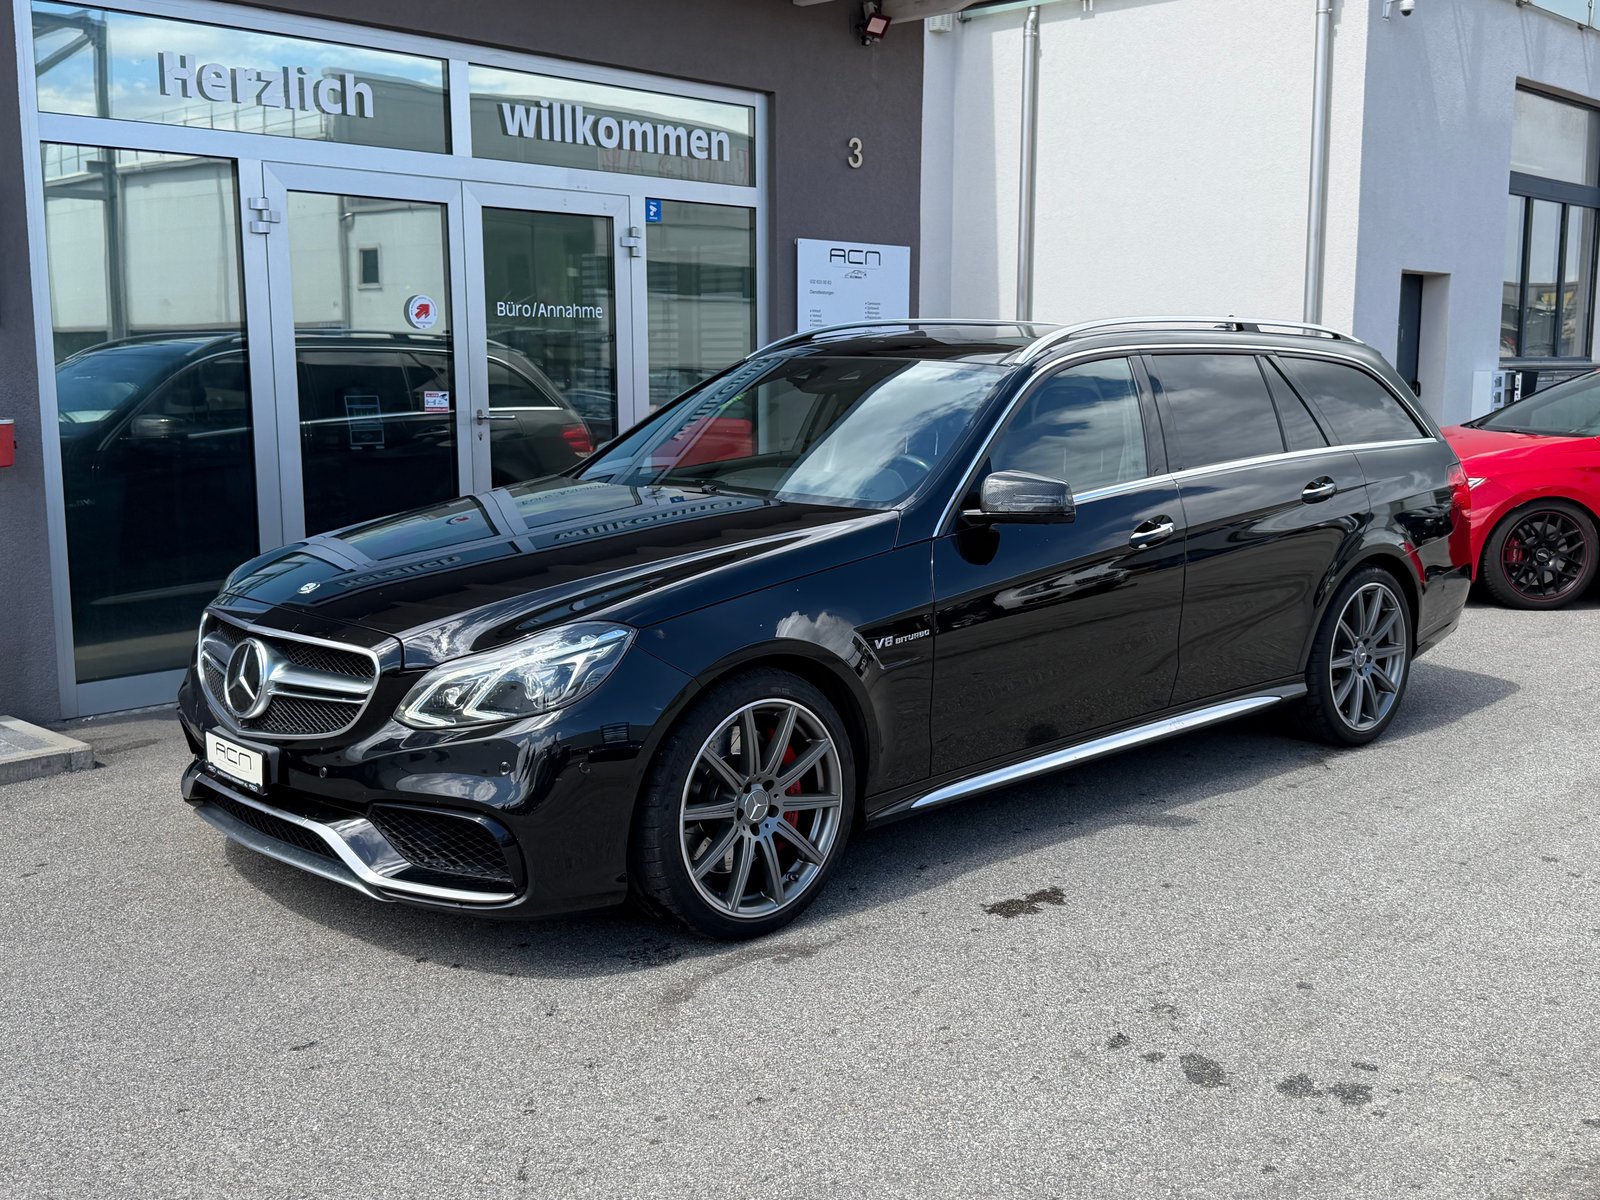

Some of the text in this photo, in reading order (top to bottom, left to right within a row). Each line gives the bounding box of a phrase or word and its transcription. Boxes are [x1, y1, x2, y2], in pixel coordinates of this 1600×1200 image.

[158, 51, 730, 161] Herzlich willkommen
[848, 137, 863, 169] 3
[830, 248, 881, 266] ACN
[496, 301, 603, 318] Büro/Annahme
[874, 629, 930, 650] V8 BITURBO
[215, 741, 252, 770] ACN
